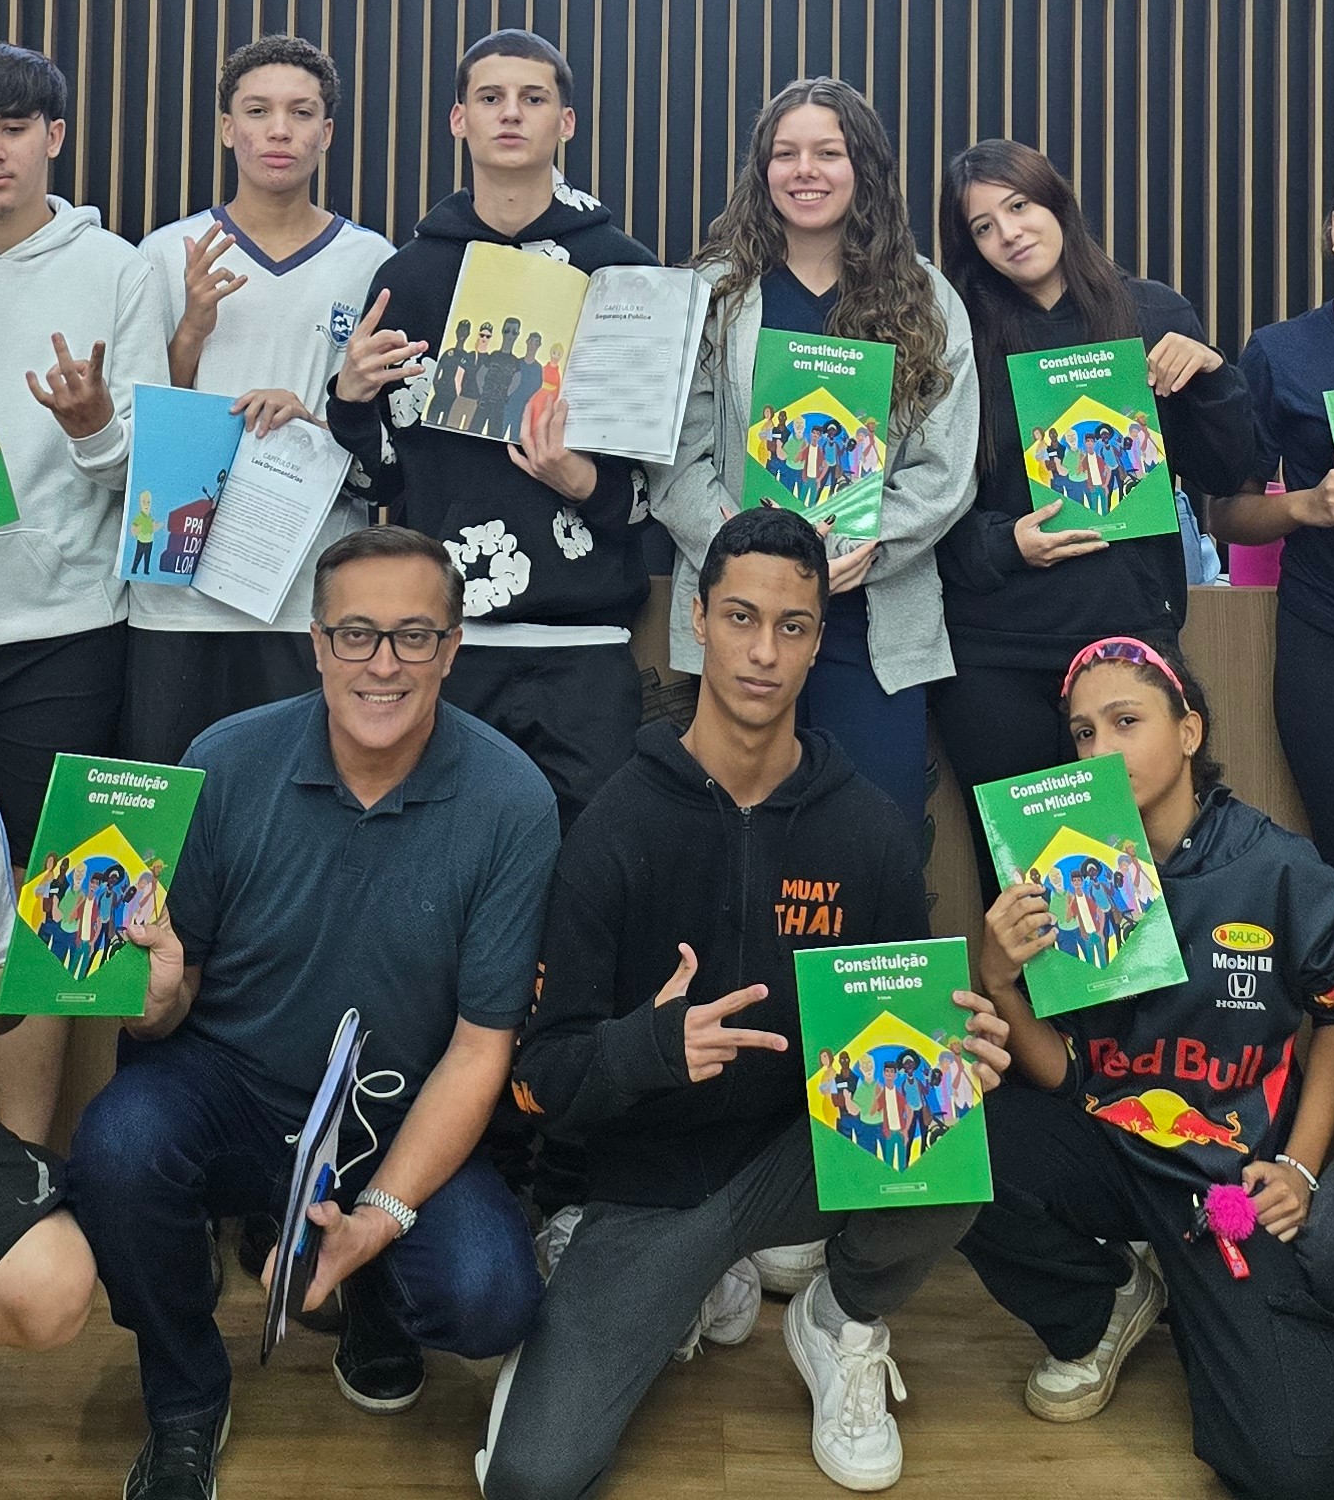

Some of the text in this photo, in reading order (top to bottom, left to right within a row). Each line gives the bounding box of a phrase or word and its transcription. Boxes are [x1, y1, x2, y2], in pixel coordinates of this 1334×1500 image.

[788, 341, 864, 361] Constituição
[1039, 350, 1115, 370] Constituição
[793, 360, 856, 376] em Miúdos
[1048, 366, 1112, 385] em Miúdos
[183, 516, 204, 535] PPA
[174, 555, 195, 574] LOA
[87, 768, 169, 792] Constituição
[1010, 769, 1093, 799] Constituição
[88, 791, 156, 810] em Miúdos
[1022, 790, 1092, 816] em Miúdos
[781, 879, 841, 903] MUAY
[774, 904, 843, 937] THAI
[1228, 929, 1266, 944] RAUCH
[833, 953, 929, 974] Constituição
[1212, 952, 1256, 971] Mobil
[843, 974, 923, 994] em Miúdos
[1216, 999, 1266, 1011] HONDA
[1088, 1036, 1263, 1091] Red Bull
